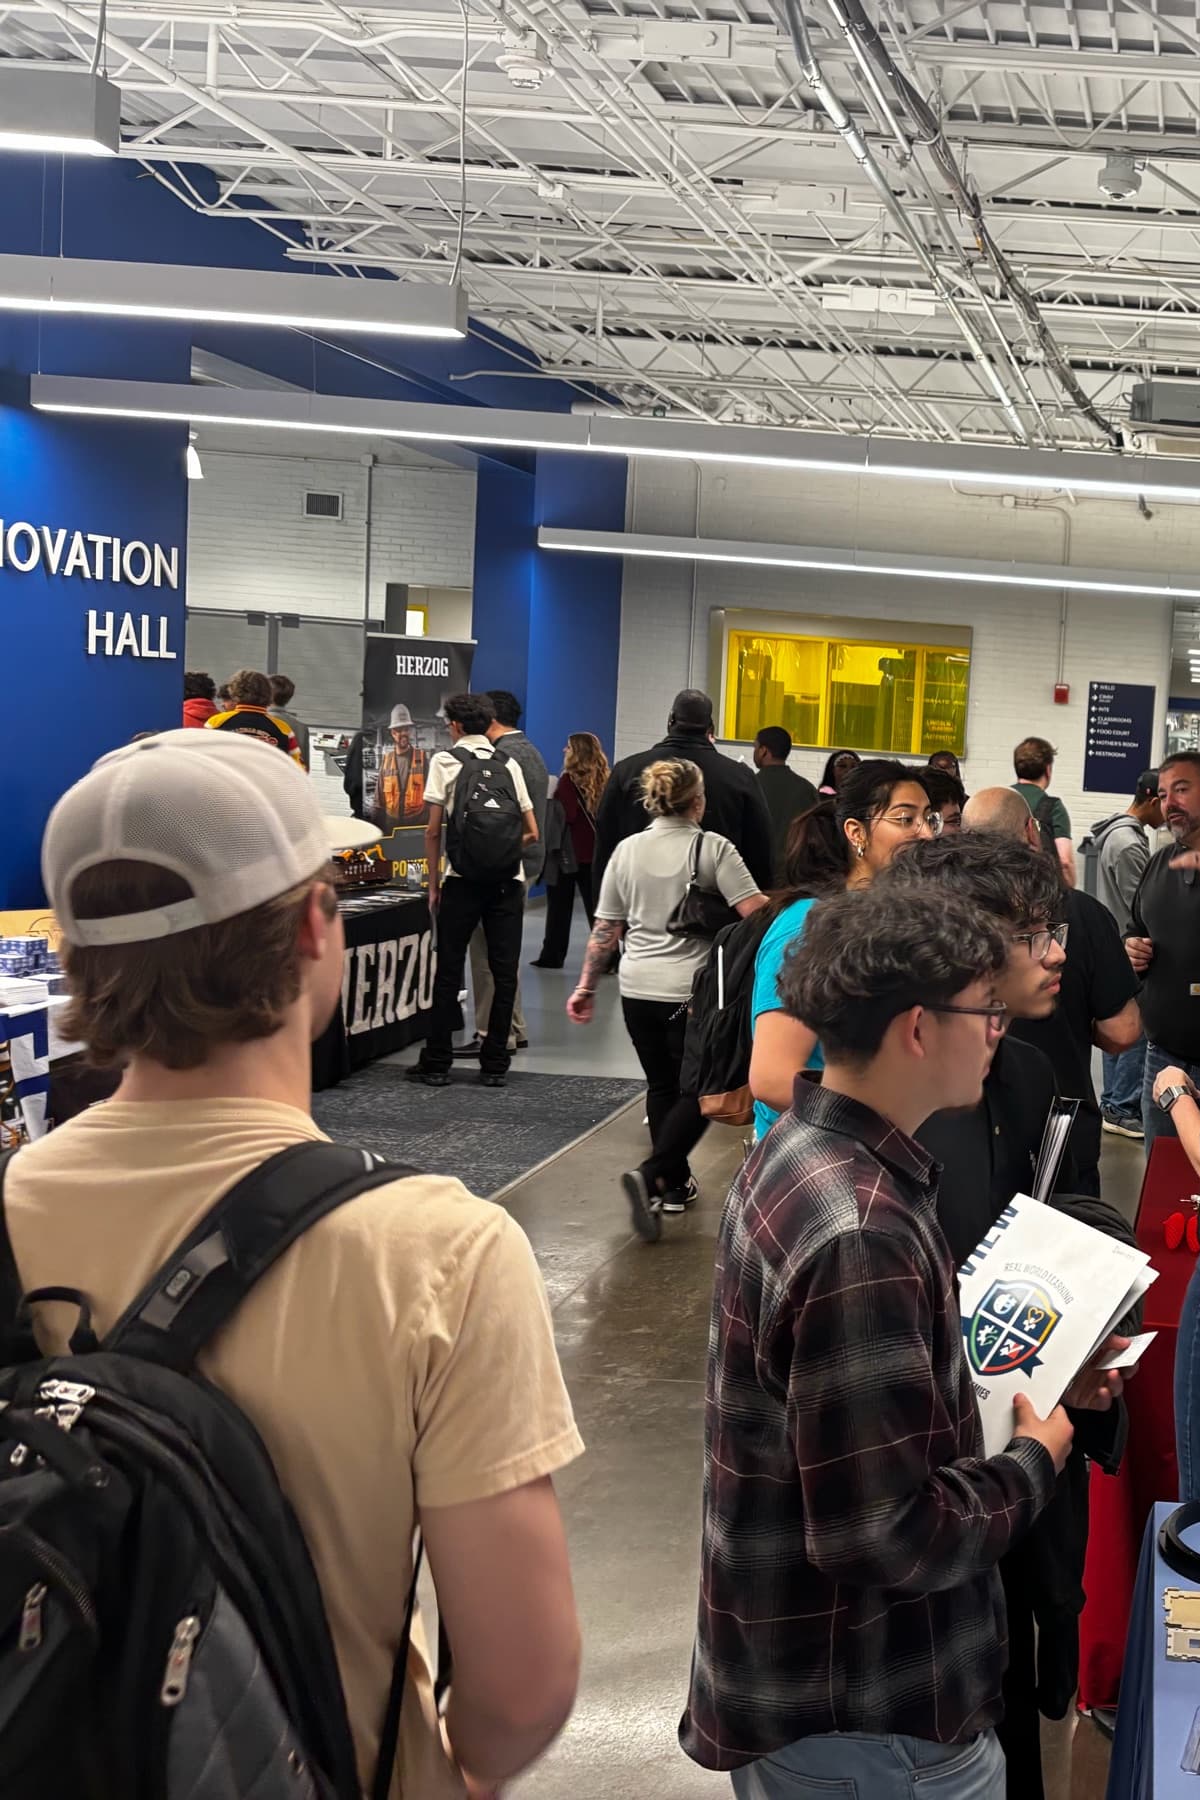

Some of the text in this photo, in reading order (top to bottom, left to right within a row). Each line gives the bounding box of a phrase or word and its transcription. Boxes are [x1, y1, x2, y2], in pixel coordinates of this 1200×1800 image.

[0, 519, 179, 590] OVATION
[88, 609, 177, 659] HALL
[395, 654, 449, 677] HERZOG
[1096, 728, 1112, 736] FOOD
